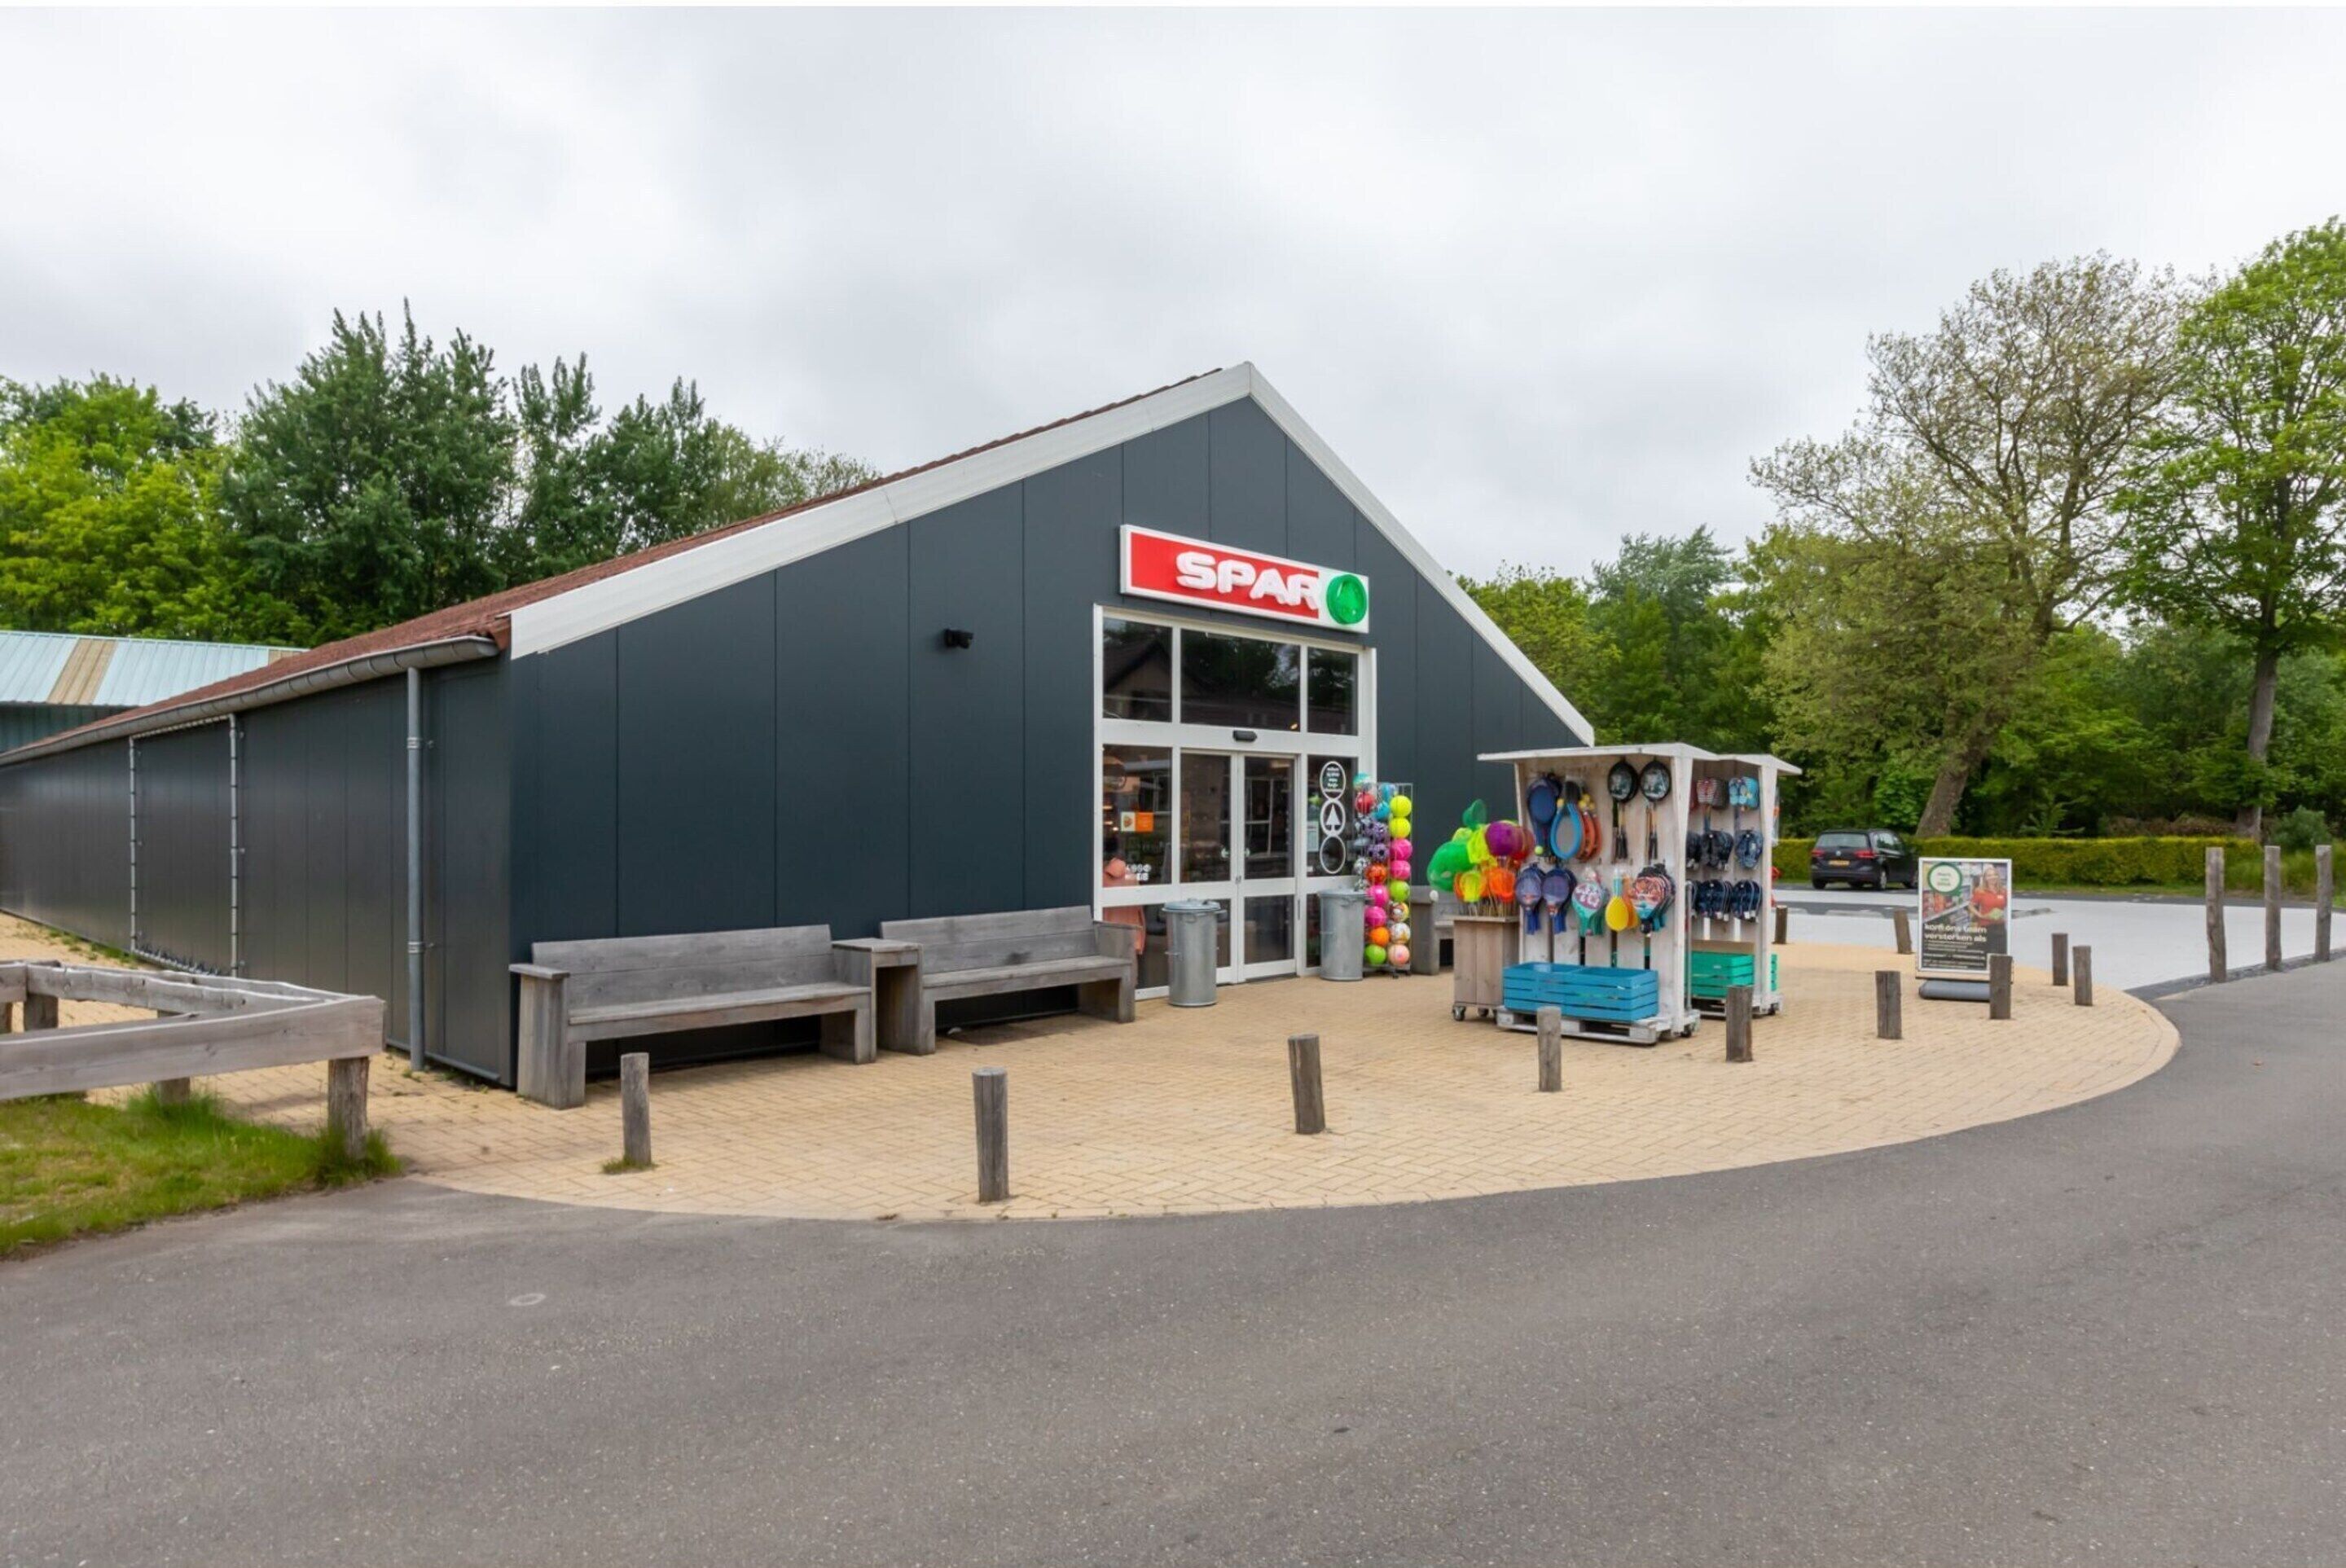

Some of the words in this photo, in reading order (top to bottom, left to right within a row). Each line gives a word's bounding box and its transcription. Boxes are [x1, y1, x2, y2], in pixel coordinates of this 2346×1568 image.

[1175, 551, 1320, 610] SPAR
[1963, 925, 1988, 933] team
[1924, 933, 1972, 941] versterken
[1974, 934, 1987, 942] als
